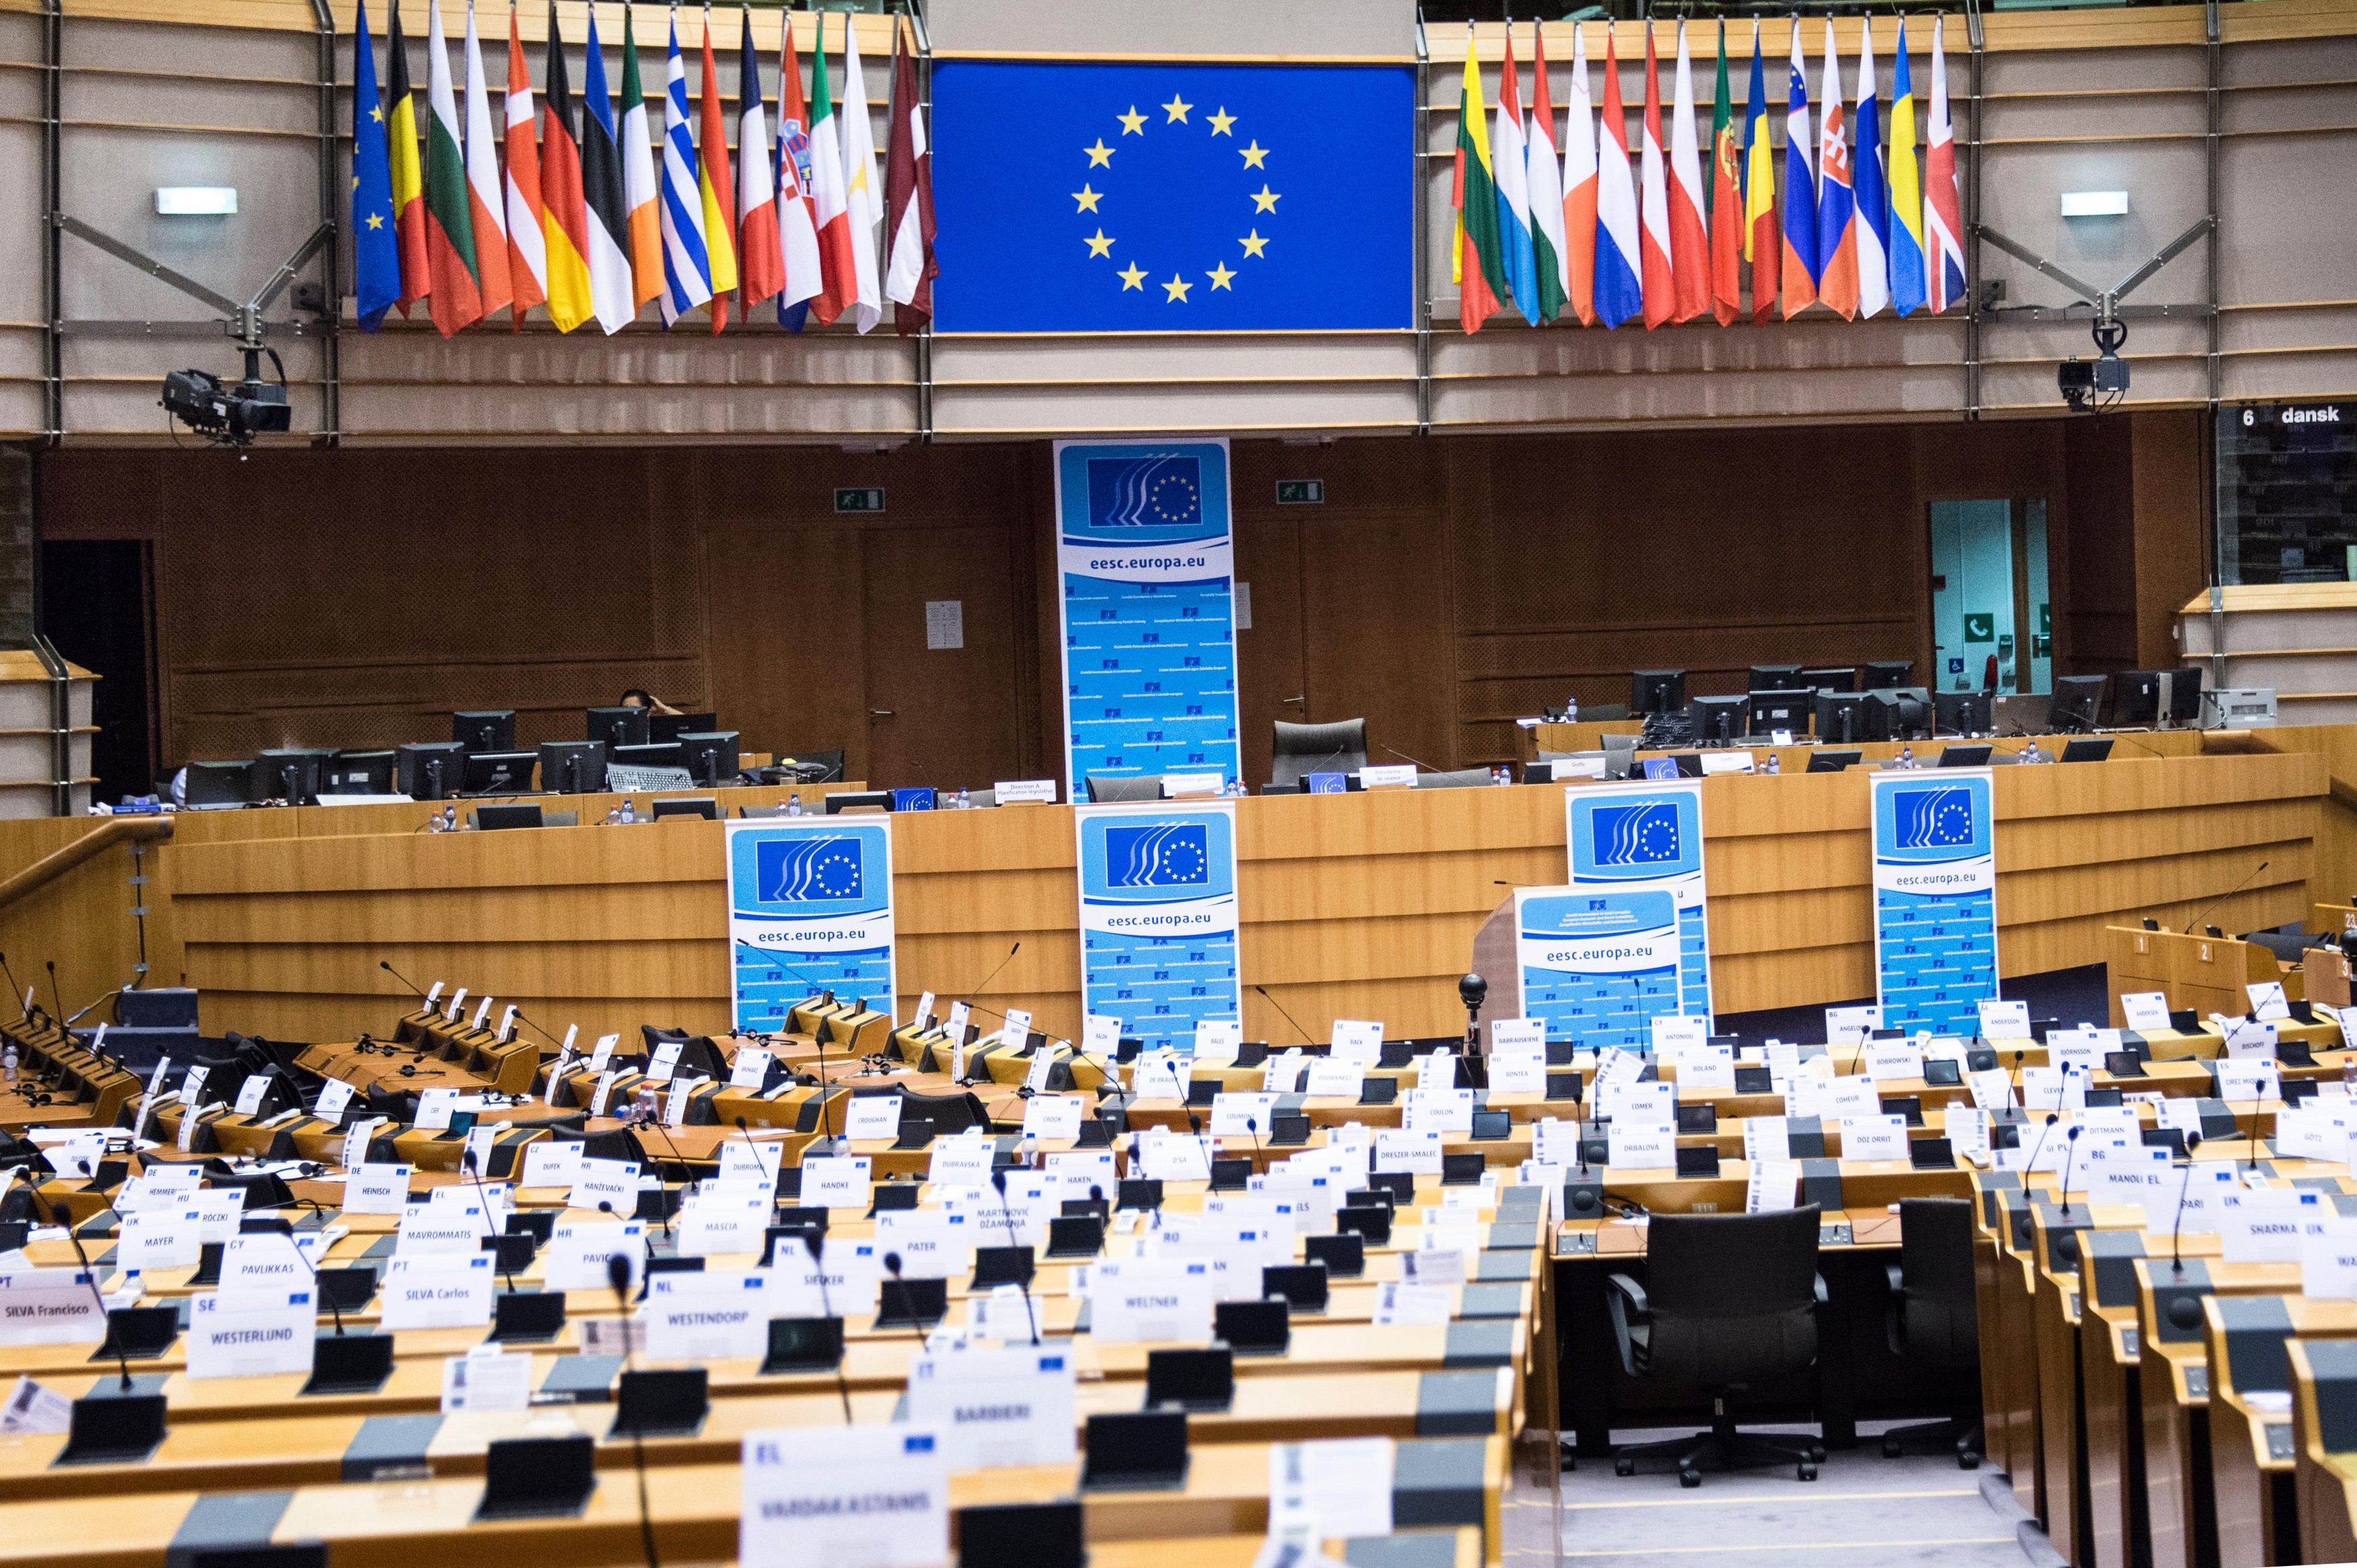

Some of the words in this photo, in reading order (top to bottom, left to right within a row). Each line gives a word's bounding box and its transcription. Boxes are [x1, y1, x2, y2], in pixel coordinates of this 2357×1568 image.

[2243, 410, 2254, 425] 6
[2282, 406, 2340, 423] dansk
[1090, 556, 1205, 571] eesc.europa.eu
[1897, 872, 1977, 886] eesc.europa.eu
[1108, 913, 1211, 927] eesc.europa.eu
[759, 929, 866, 942] eesc.europa.eu
[2139, 938, 2144, 952] 1
[1547, 946, 1653, 962] eesc.europa.eu
[2202, 944, 2208, 960] 2
[2342, 960, 2348, 977] 3
[2241, 1042, 2265, 1050] BISCHOFF
[1876, 1057, 1911, 1065] BOBROWSKI
[2225, 1078, 2241, 1086] CIREZ
[1836, 1094, 1859, 1104] COHEUR
[858, 1116, 887, 1124] CROUGHAN
[2090, 1126, 2125, 1134] DITTMANN
[1872, 1135, 1891, 1143] ORRIT
[1624, 1143, 1659, 1152] DRBALOVÁ
[1380, 1150, 1437, 1159] DRESZER-SMALEC
[2092, 1151, 2105, 1159] BG
[581, 1161, 591, 1169] HR
[352, 1167, 362, 1175] DE
[2148, 1174, 2161, 1184] EL
[1251, 1181, 1264, 1190] BE
[362, 1187, 390, 1196] HEINISCH
[436, 1191, 446, 1199] EL
[966, 1192, 981, 1200] HR
[177, 1194, 190, 1203] HU
[2224, 1196, 2241, 1207] UK
[1210, 1202, 1224, 1211] HU
[407, 1208, 420, 1216] CY
[126, 1217, 140, 1227] UK
[882, 1217, 894, 1227] PL
[557, 1229, 572, 1239] HR
[2250, 1224, 2297, 1235] SHARMA
[407, 1230, 471, 1240] MAVROMMATIS
[1163, 1232, 1180, 1243] RO
[144, 1236, 174, 1248] MAYER
[231, 1239, 245, 1250] CY
[907, 1242, 936, 1252] PATER
[781, 1245, 795, 1255] NL
[241, 1264, 294, 1276] PAVLIKKAS
[393, 1261, 408, 1271] PT
[657, 1281, 673, 1292] NL
[405, 1289, 433, 1301] SILVA
[437, 1287, 470, 1299] Carlos
[198, 1298, 216, 1313] SE
[1126, 1296, 1179, 1308] WELTNER
[5, 1305, 34, 1317] SILVA
[38, 1303, 89, 1316] Francisco
[668, 1311, 749, 1327] WESTENDORP
[211, 1327, 293, 1346] WESTERLUND
